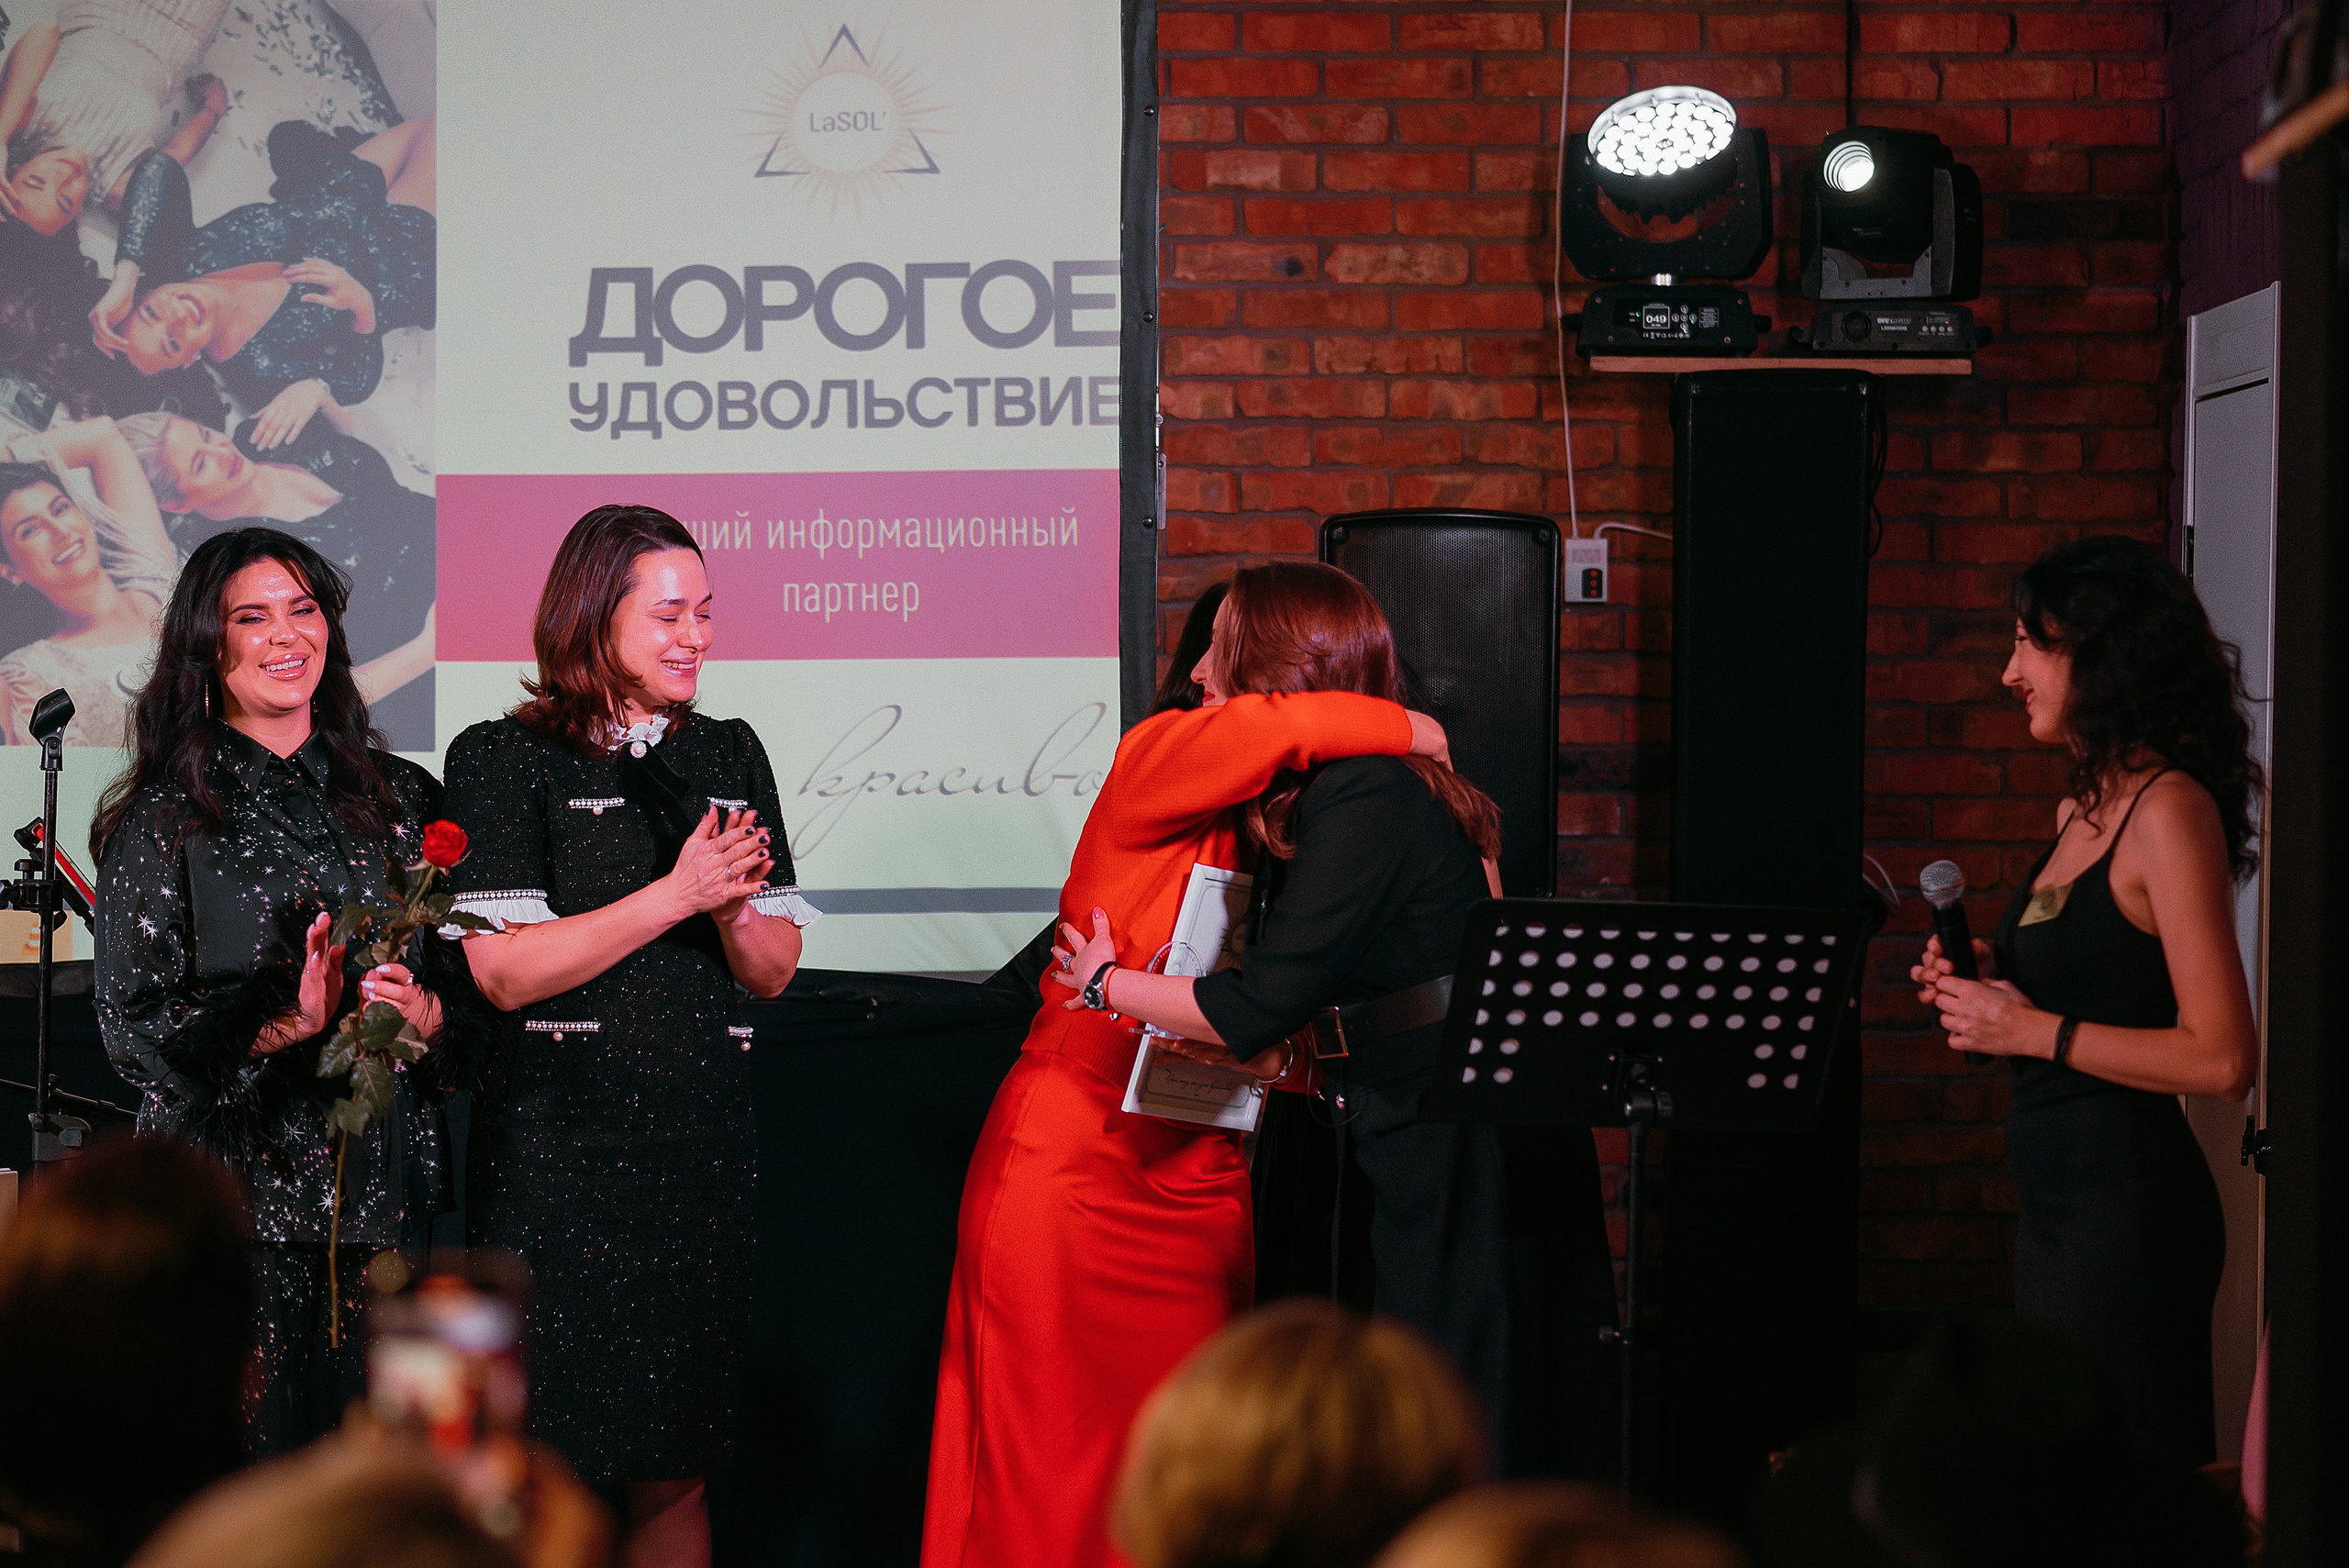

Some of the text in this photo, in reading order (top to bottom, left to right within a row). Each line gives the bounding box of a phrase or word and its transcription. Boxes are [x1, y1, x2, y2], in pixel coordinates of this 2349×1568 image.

[568, 259, 1119, 367] ДОРОГОЕ
[568, 375, 1119, 439] УДОВОЛЬСТВИЕ
[767, 507, 1078, 560] информационный
[783, 581, 919, 623] партнер
